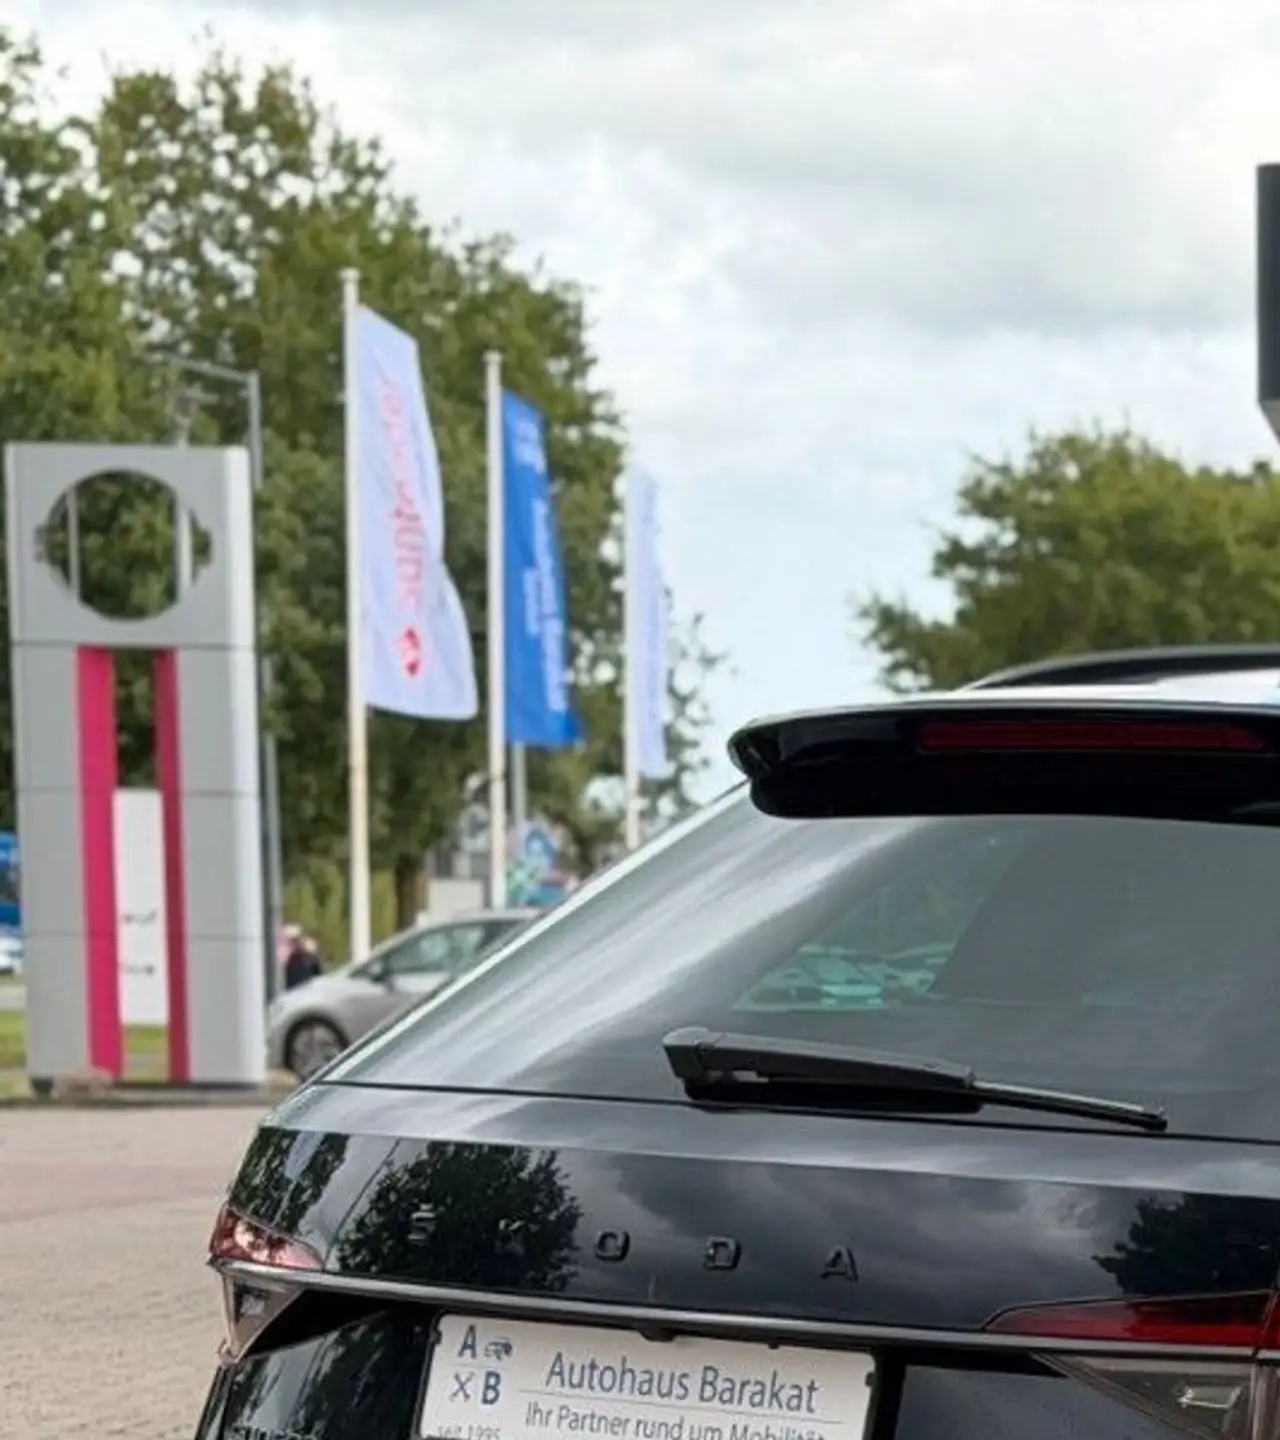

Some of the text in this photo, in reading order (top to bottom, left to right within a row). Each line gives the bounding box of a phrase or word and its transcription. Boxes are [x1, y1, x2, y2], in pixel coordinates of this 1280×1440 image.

[457, 1324, 478, 1359] A
[545, 1351, 820, 1414] Autohaus Barakat
[525, 1401, 554, 1427] Ihr
[557, 1406, 631, 1436] Partner
